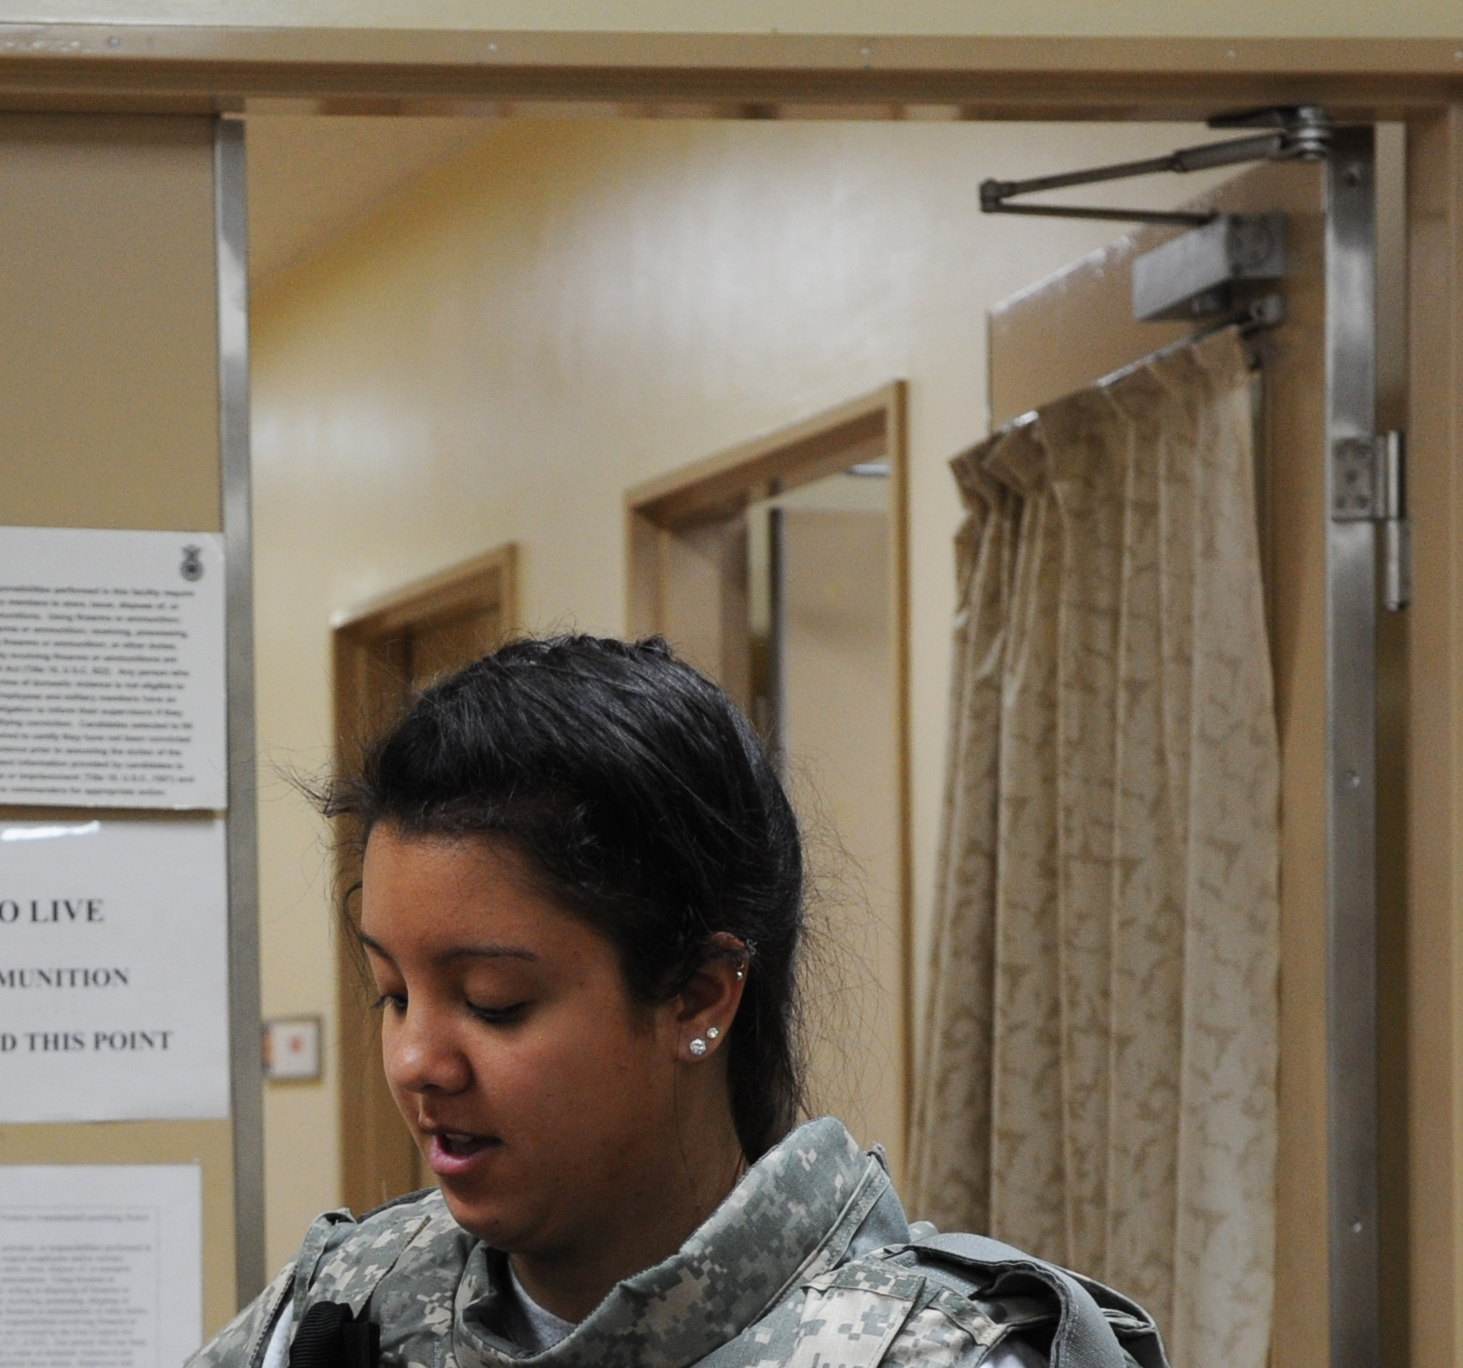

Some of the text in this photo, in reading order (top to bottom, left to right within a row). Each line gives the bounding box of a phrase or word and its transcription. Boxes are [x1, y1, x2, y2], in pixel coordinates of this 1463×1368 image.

[29, 898, 105, 925] LIVE
[23, 1030, 86, 1053] THIS
[93, 1030, 174, 1052] POINT
